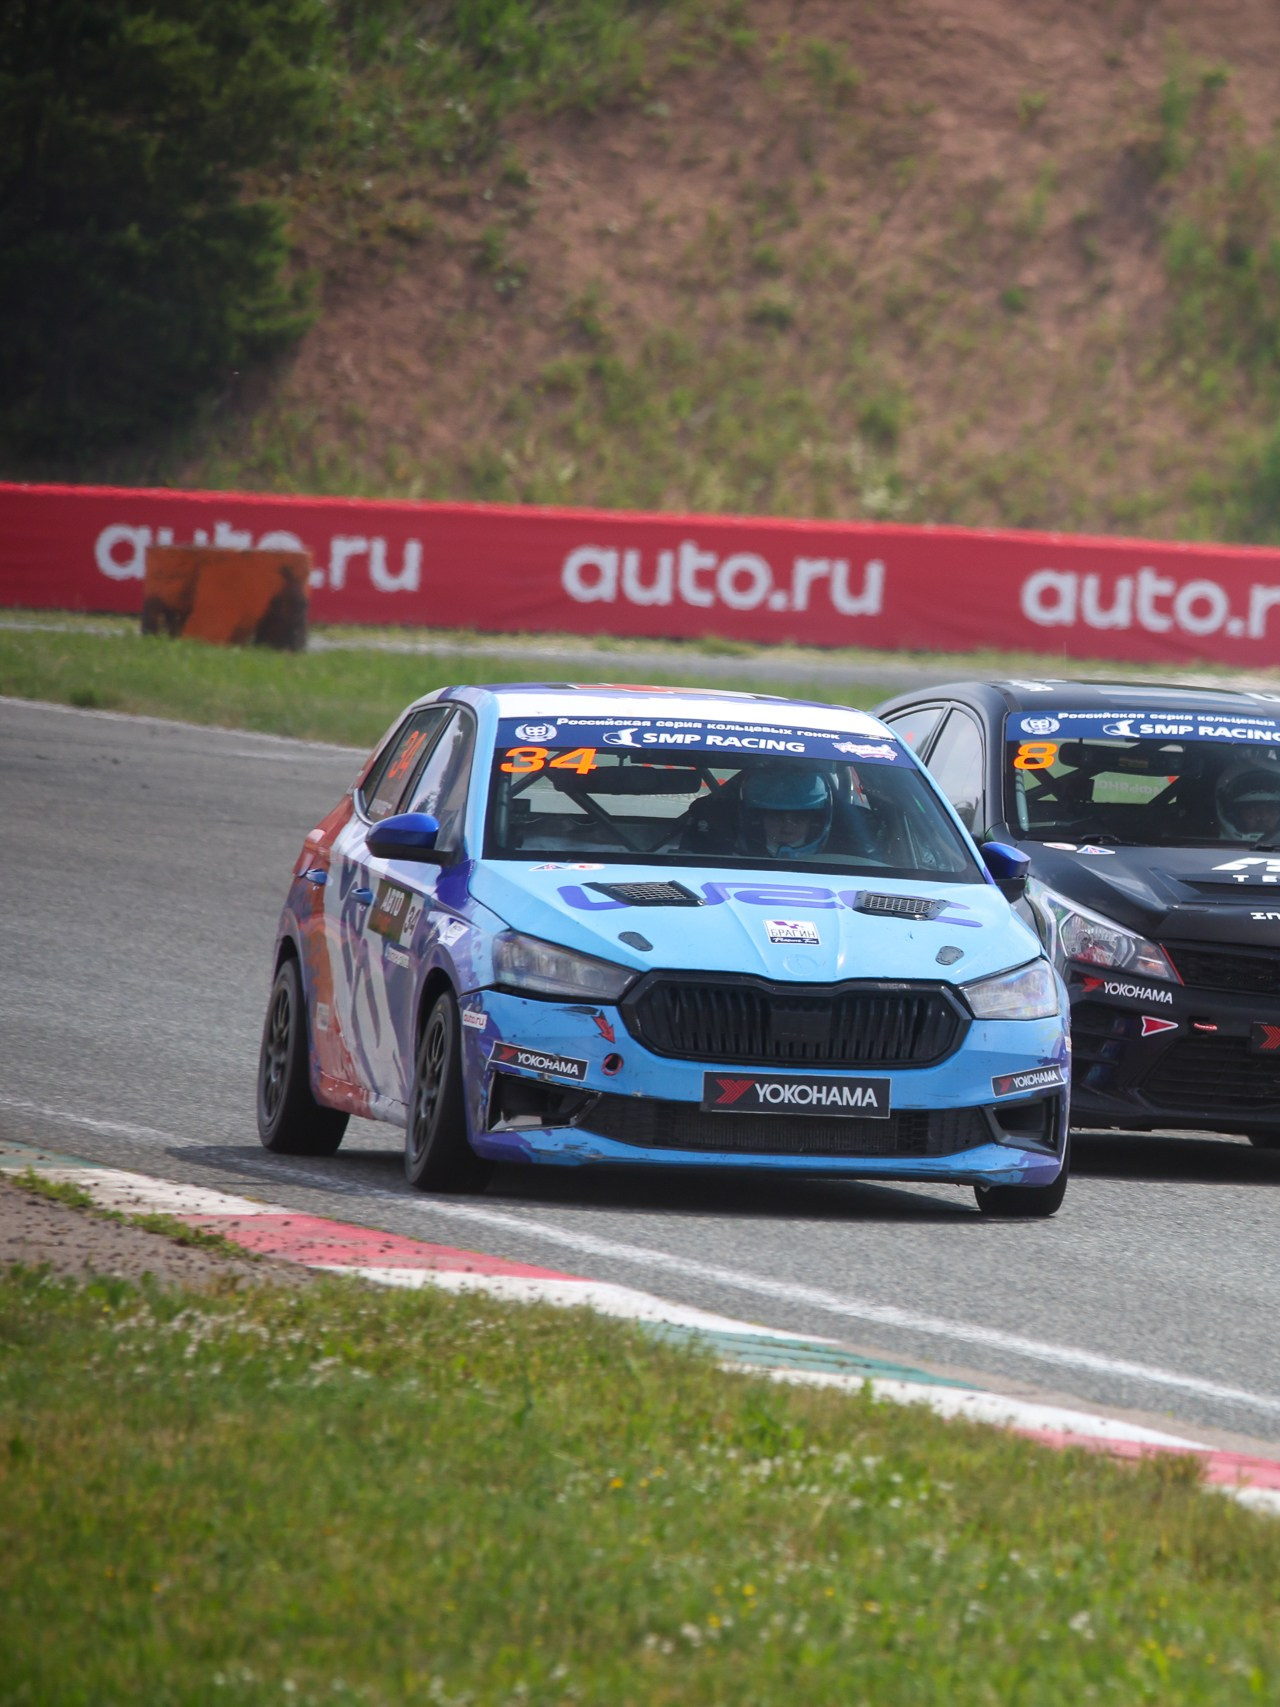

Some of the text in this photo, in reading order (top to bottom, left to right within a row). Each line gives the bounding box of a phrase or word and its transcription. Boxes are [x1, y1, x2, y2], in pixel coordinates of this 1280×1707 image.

[562, 541, 884, 615] auto.ru
[1058, 712, 1145, 720] Российская
[1150, 713, 1193, 721] серия
[557, 718, 840, 740] Российская серия кольцевых гонок
[1140, 724, 1193, 735] SMP
[643, 732, 805, 752] SMP RACING
[500, 746, 598, 775] 34
[1013, 742, 1059, 770] 8
[1103, 981, 1173, 1004] YOKOHAMA
[516, 1051, 579, 1076] YOKOHAMA
[1012, 1068, 1059, 1089] YOKOHAMA
[754, 1080, 878, 1109] YOKOHAMA
